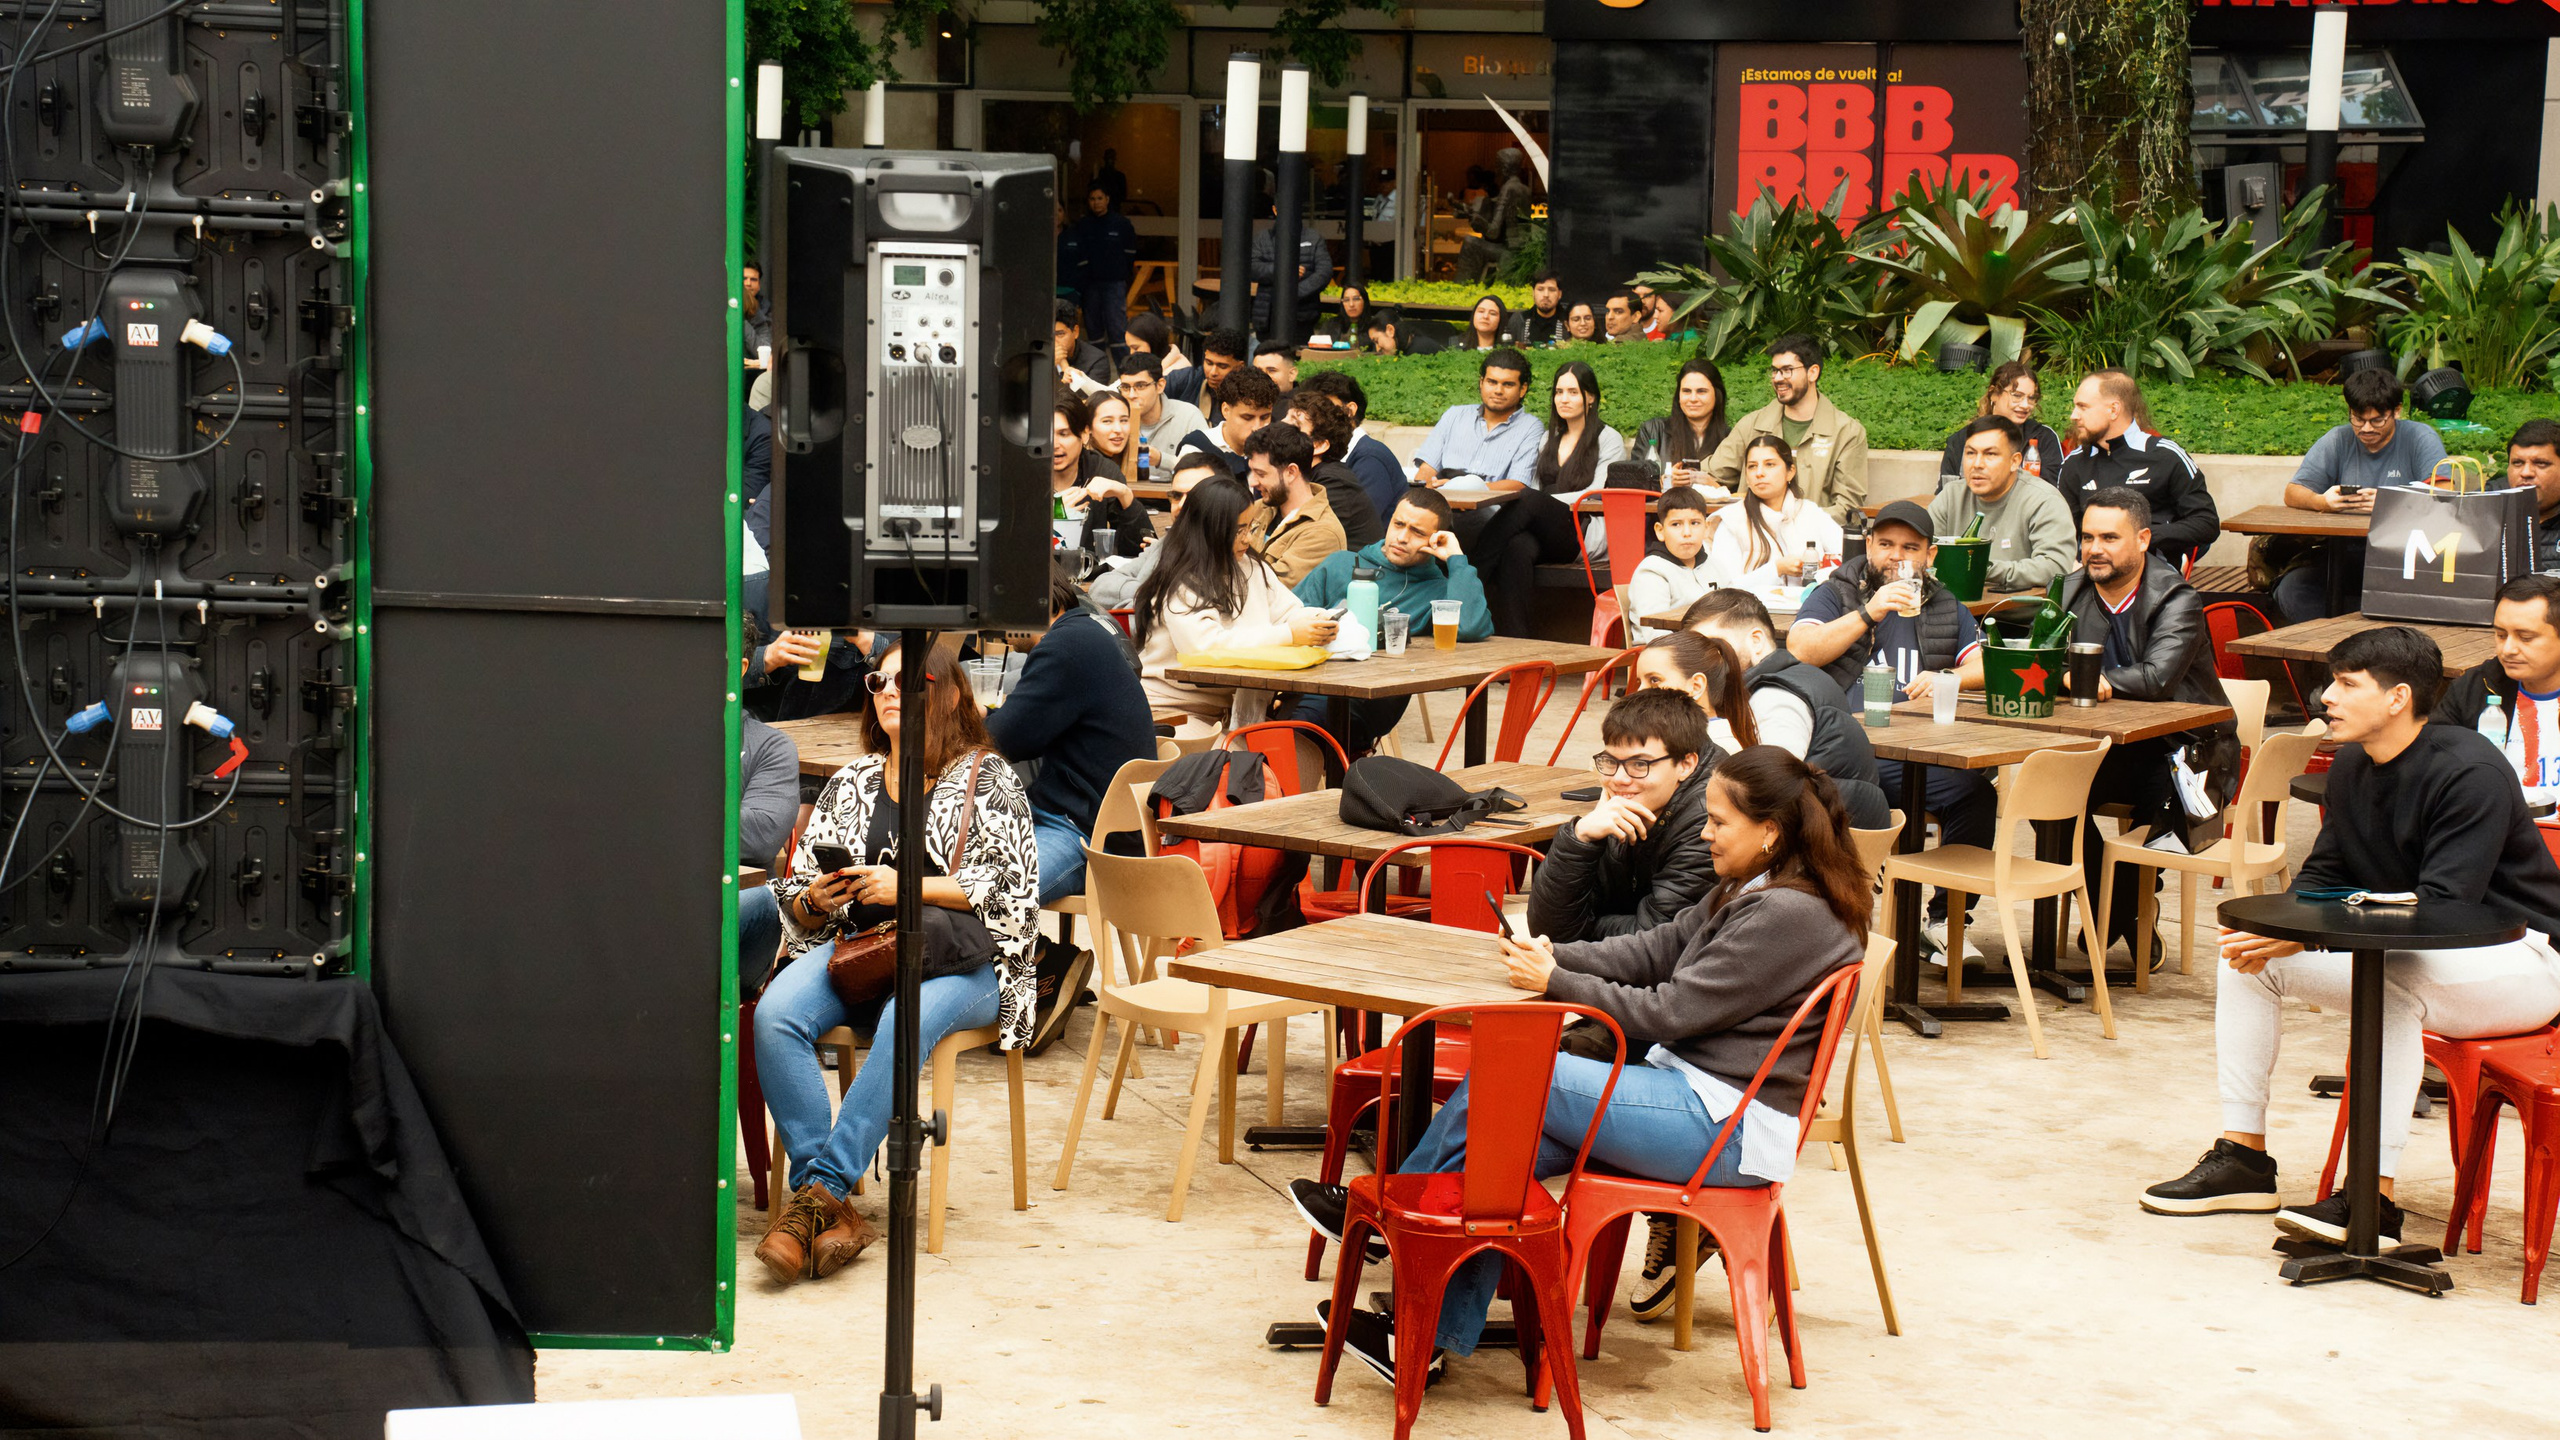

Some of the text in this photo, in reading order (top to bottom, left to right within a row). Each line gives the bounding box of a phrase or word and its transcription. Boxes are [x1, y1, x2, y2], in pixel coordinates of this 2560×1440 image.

[1741, 68, 1811, 84] ¡Estamos
[1815, 67, 1836, 81] de
[130, 325, 157, 340] AV
[134, 710, 161, 723] AV
